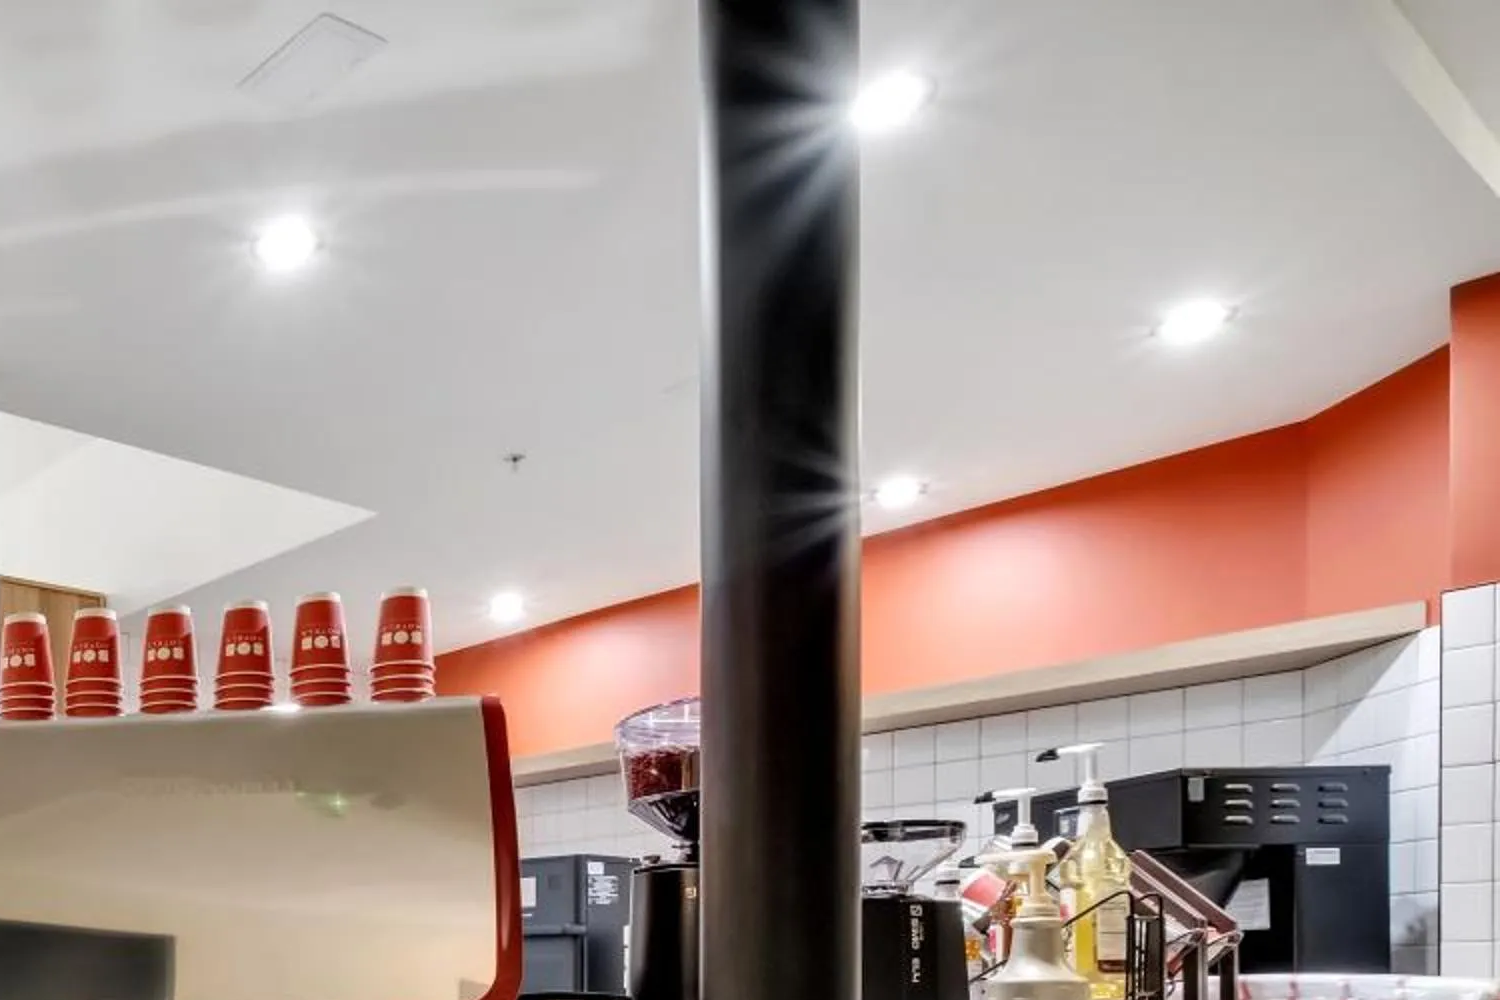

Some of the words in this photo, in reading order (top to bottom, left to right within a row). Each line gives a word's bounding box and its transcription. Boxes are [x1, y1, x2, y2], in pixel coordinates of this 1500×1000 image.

[300, 635, 341, 650] BOB
[380, 630, 423, 646] BOB
[147, 647, 184, 661] BOB
[225, 642, 264, 656] BOB
[72, 650, 109, 663] BOB
